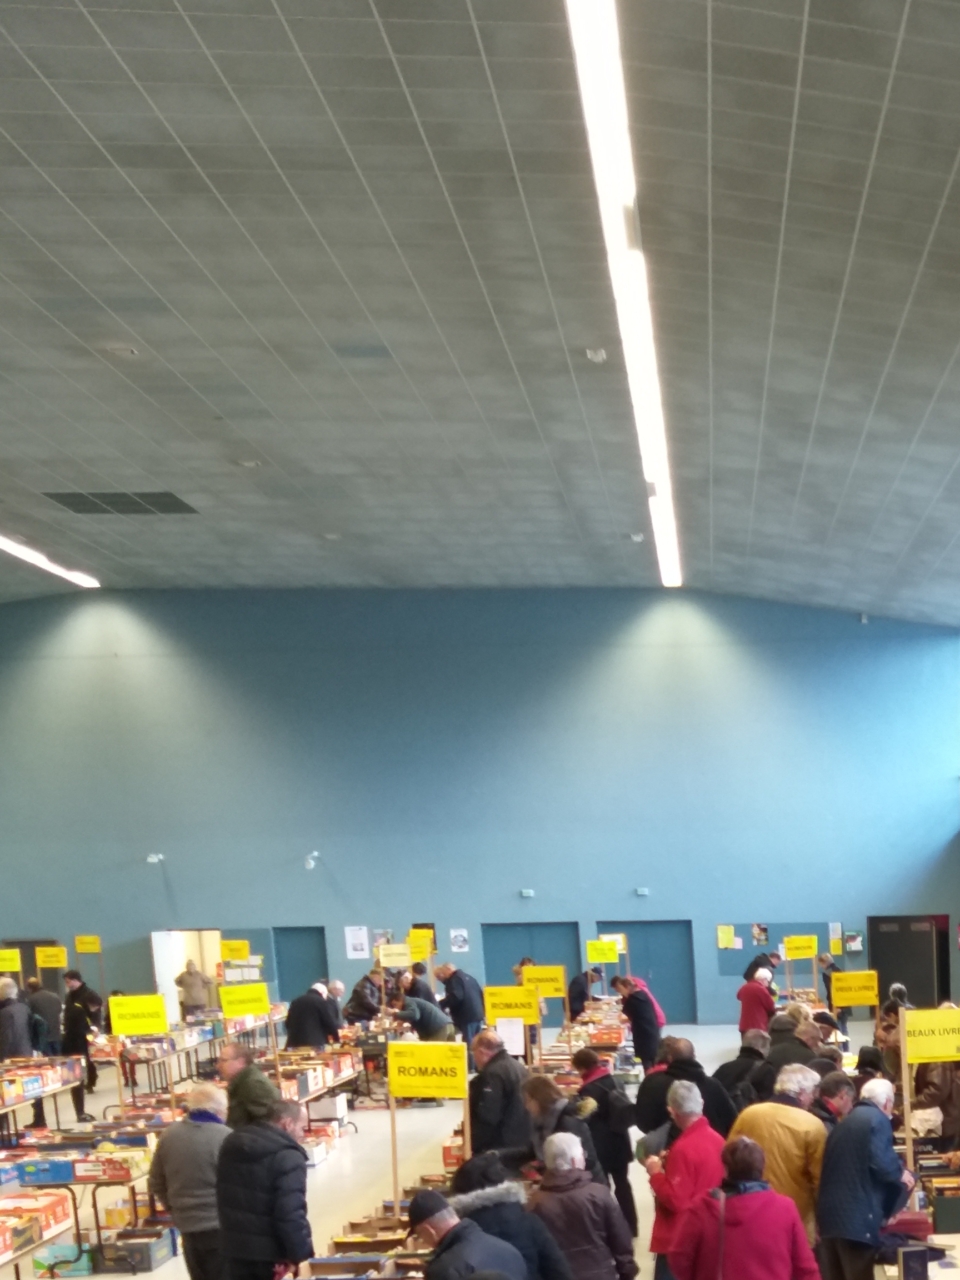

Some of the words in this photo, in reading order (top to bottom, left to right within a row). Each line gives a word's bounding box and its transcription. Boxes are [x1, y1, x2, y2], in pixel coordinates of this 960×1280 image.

[527, 976, 560, 984] ROMANS
[490, 1001, 533, 1011] ROMANS
[117, 1011, 161, 1021] ROMANS
[906, 1029, 937, 1038] BEAUX
[397, 1066, 458, 1078] ROMANS
